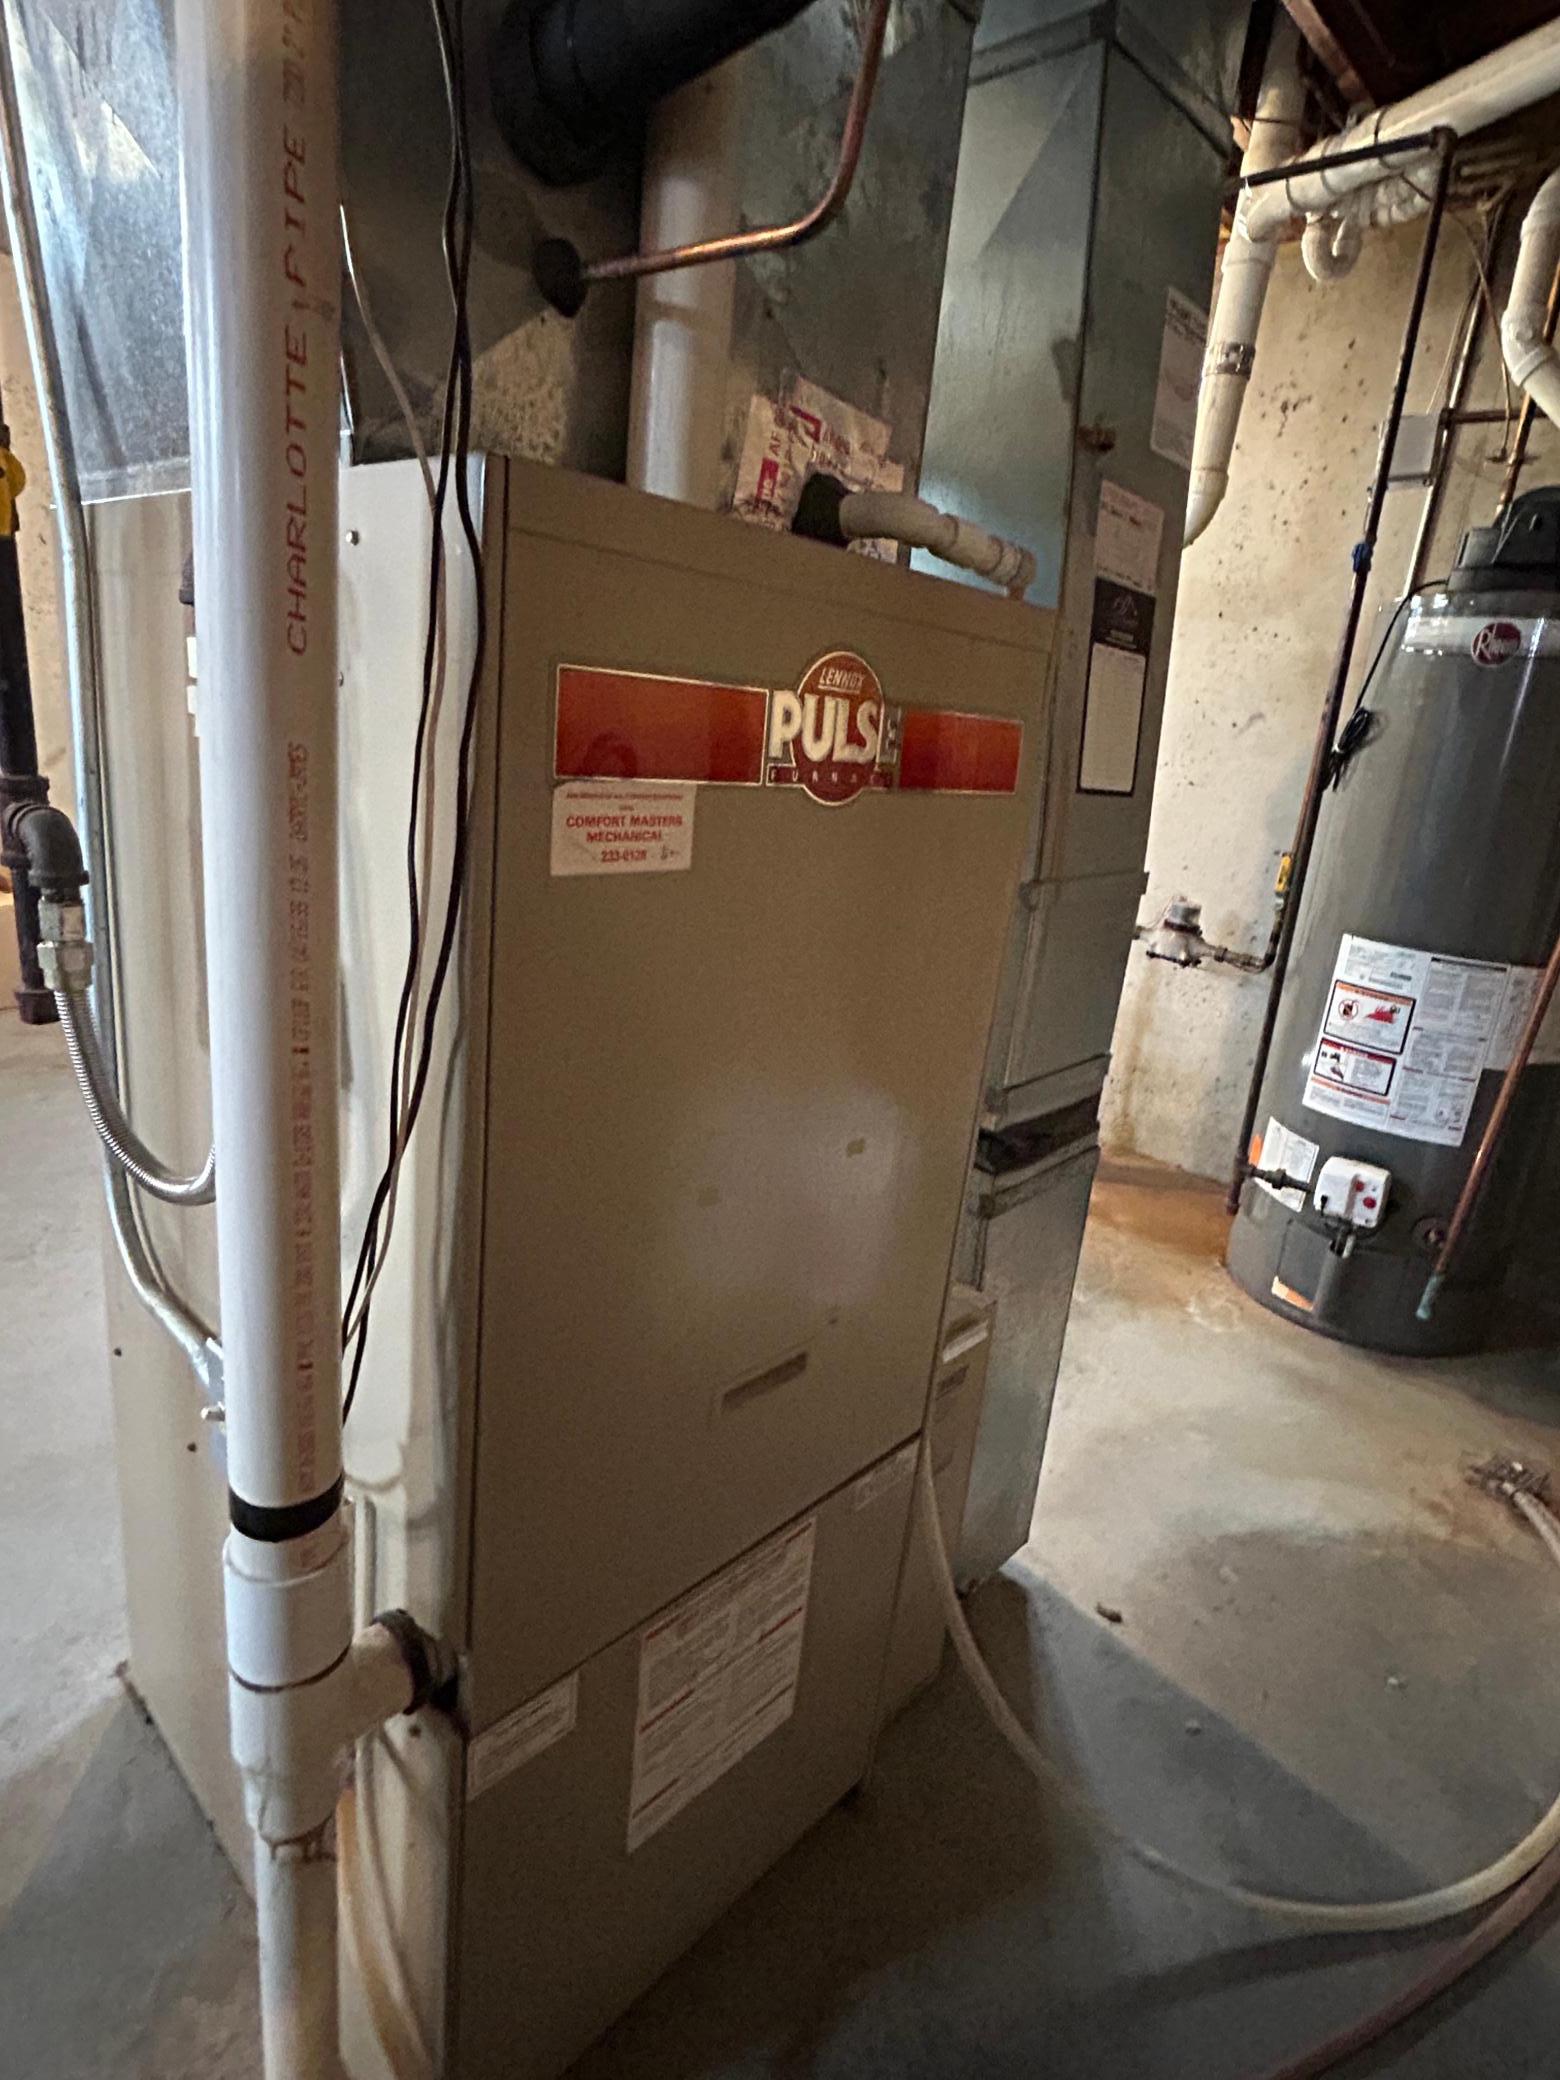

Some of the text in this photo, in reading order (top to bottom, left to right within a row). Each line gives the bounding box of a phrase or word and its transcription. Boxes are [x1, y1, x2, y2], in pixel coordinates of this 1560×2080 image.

[285, 322, 308, 655] CHARLOTTE
[819, 667, 867, 689] LENNOX
[566, 814, 683, 829] COMFORT MASTERS
[586, 830, 663, 844] MECHANICAL
